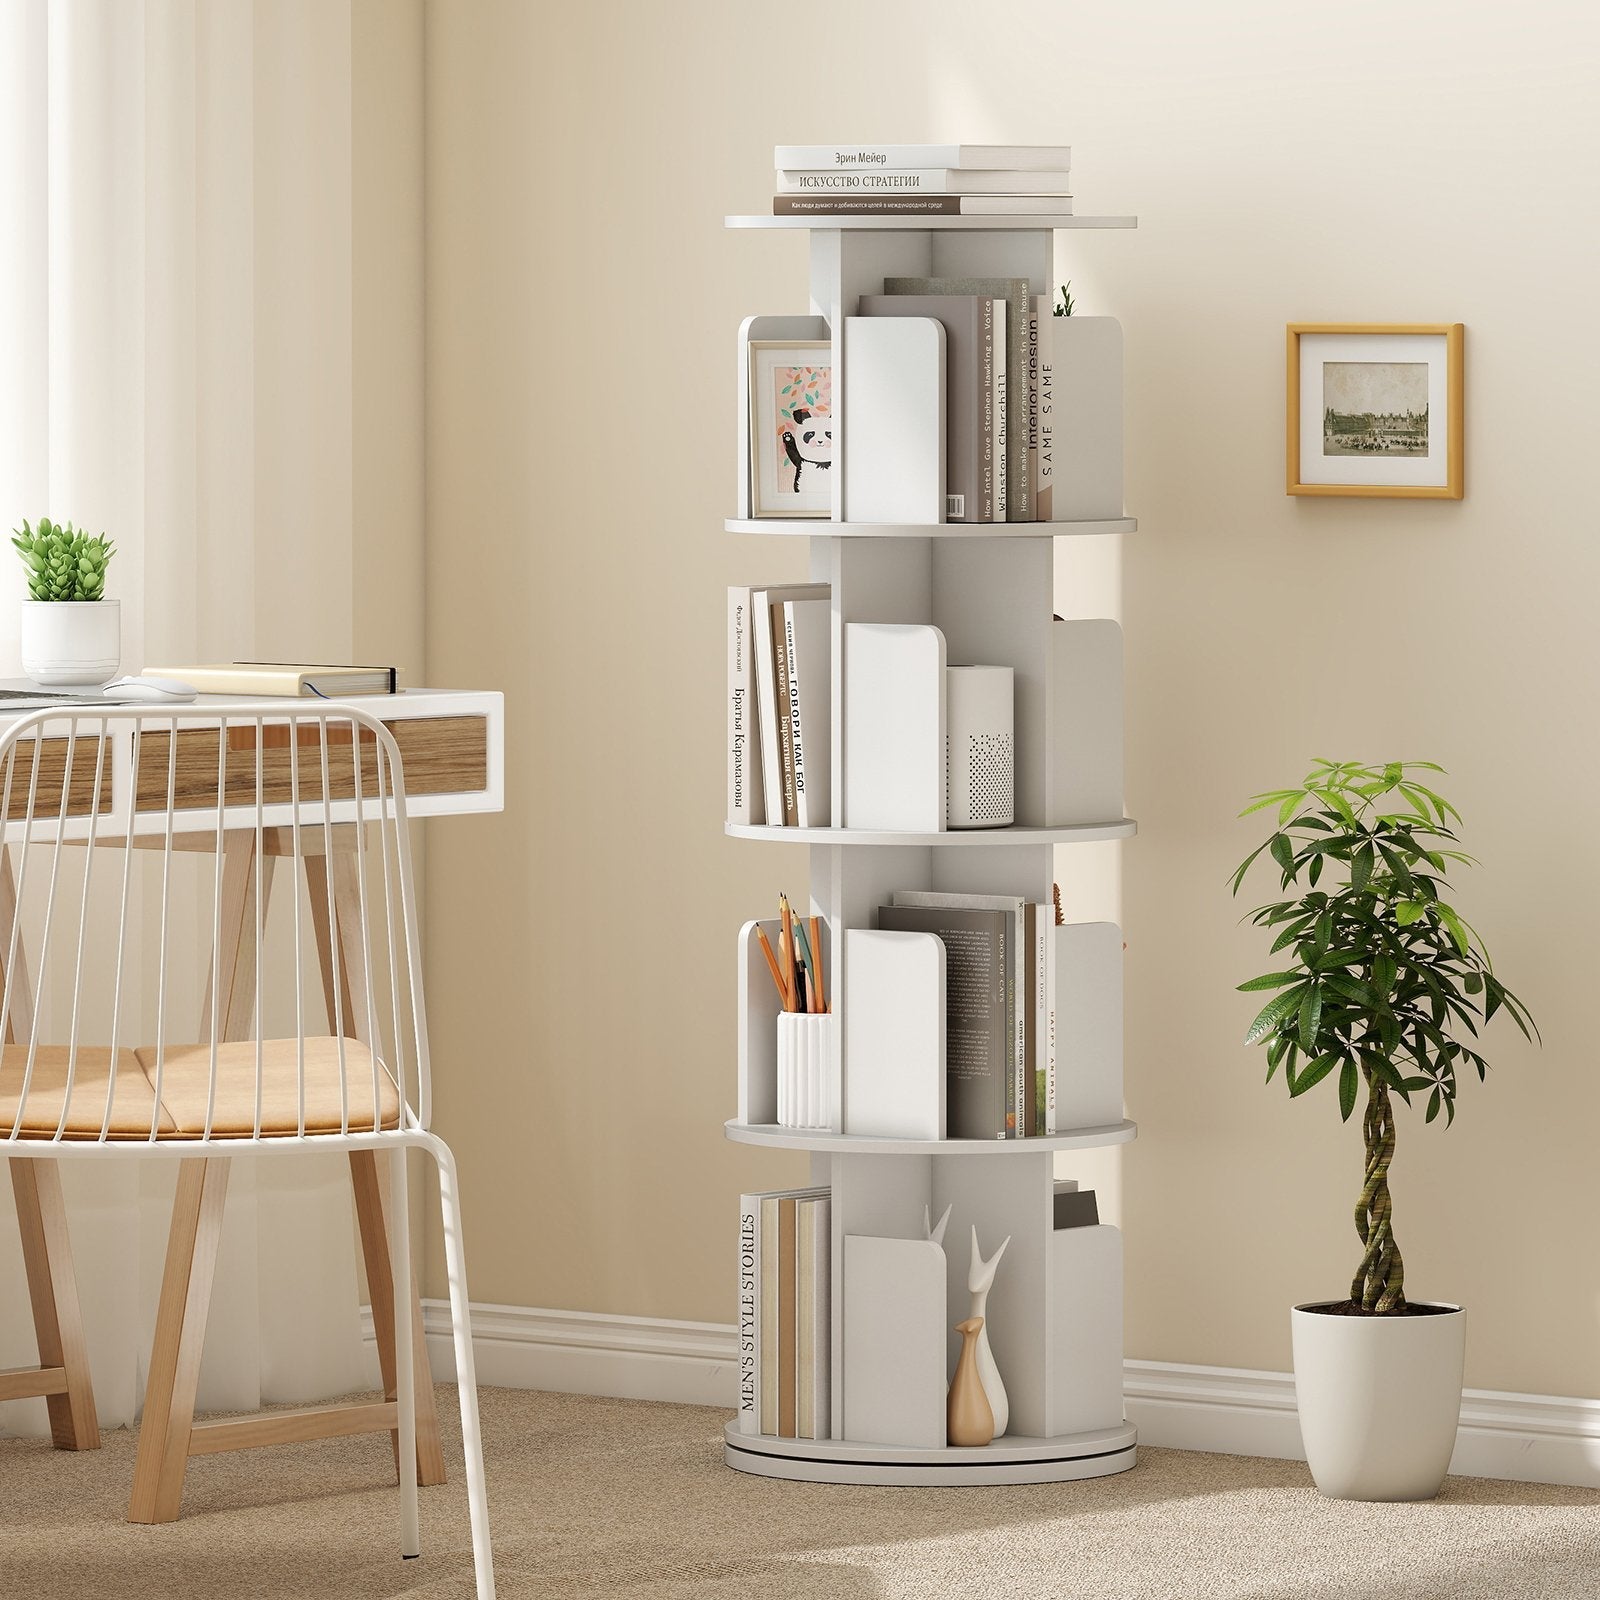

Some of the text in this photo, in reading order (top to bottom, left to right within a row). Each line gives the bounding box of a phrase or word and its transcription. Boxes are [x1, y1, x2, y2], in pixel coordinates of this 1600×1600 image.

[835, 152, 887, 166] Эрин Мейер
[799, 176, 920, 188] ИСКУССТВО СТРАТЕГИИ
[984, 346, 992, 386] Hawking
[1020, 342, 1027, 352] in
[984, 392, 992, 432] Stephen
[1029, 386, 1037, 450] Interior
[1042, 364, 1052, 476] SAME SAME
[998, 372, 1006, 512] Winston Churchill
[1022, 429, 1027, 441] an
[1021, 476, 1027, 488] to
[777, 645, 785, 664] НОРА
[732, 688, 745, 808] Братья Карамазовы
[790, 680, 800, 738] ГОВОРИ
[796, 772, 804, 793] БОГ
[780, 716, 794, 810] Бархатная смерть
[1000, 964, 1005, 976] OF
[742, 1214, 754, 1412] MEN'S STYLE STORIES
